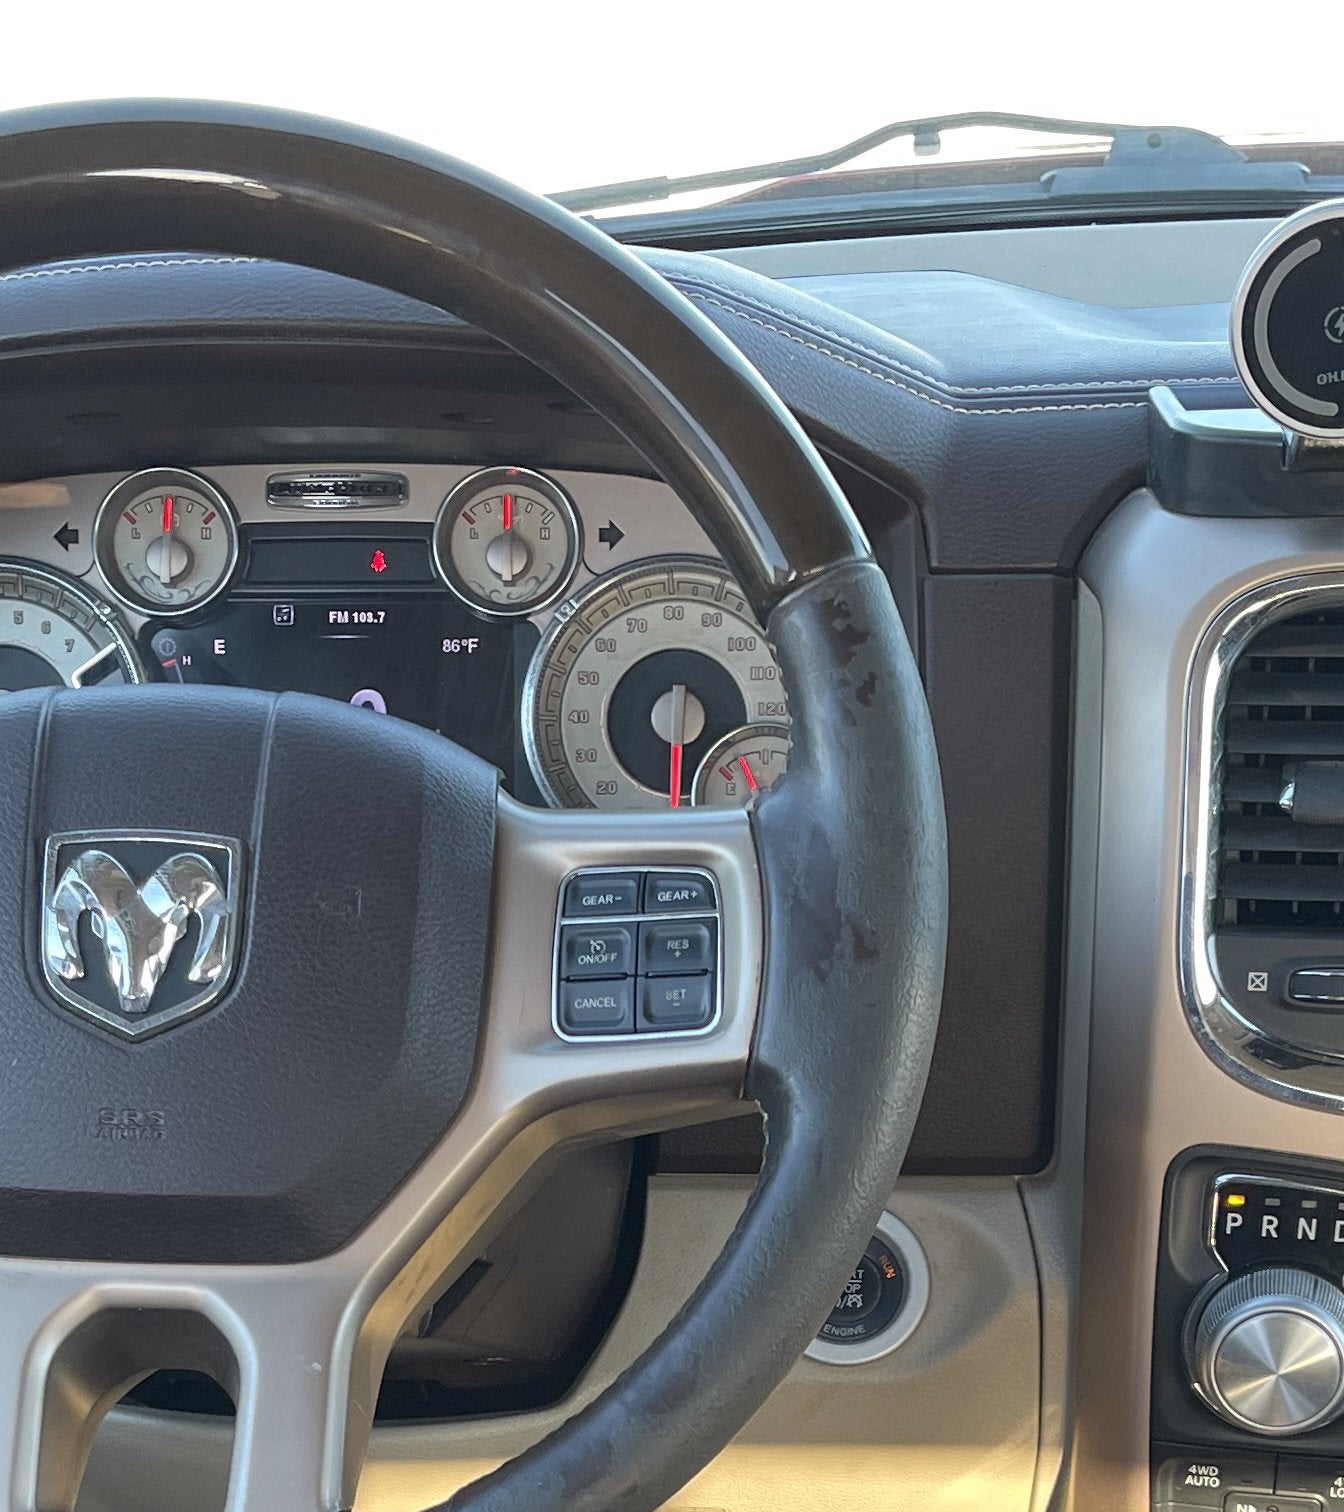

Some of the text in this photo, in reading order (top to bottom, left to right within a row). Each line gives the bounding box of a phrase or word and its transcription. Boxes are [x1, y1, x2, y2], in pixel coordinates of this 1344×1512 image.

[13, 610, 24, 625] 5
[328, 611, 349, 624] FM
[663, 606, 684, 620] 80
[41, 620, 52, 634] 6
[626, 619, 648, 633] 70
[701, 614, 722, 627] 90
[64, 638, 76, 652] 7
[213, 639, 226, 655] E
[595, 639, 617, 652] 60
[727, 637, 756, 651] 100
[577, 672, 599, 685] 50
[750, 667, 777, 680] 110
[568, 710, 589, 723] 40
[758, 703, 787, 716] 120
[575, 750, 597, 762] 30
[596, 781, 618, 794] 20
[577, 952, 618, 966] ON/OFF
[574, 997, 617, 1010] CANCEL
[1225, 1213, 1243, 1235] P
[1261, 1215, 1278, 1238] R
[1296, 1218, 1317, 1241] N
[823, 1323, 867, 1337] ENGINE
[1188, 1464, 1219, 1478] 4WD
[1184, 1474, 1220, 1488] AUTO
